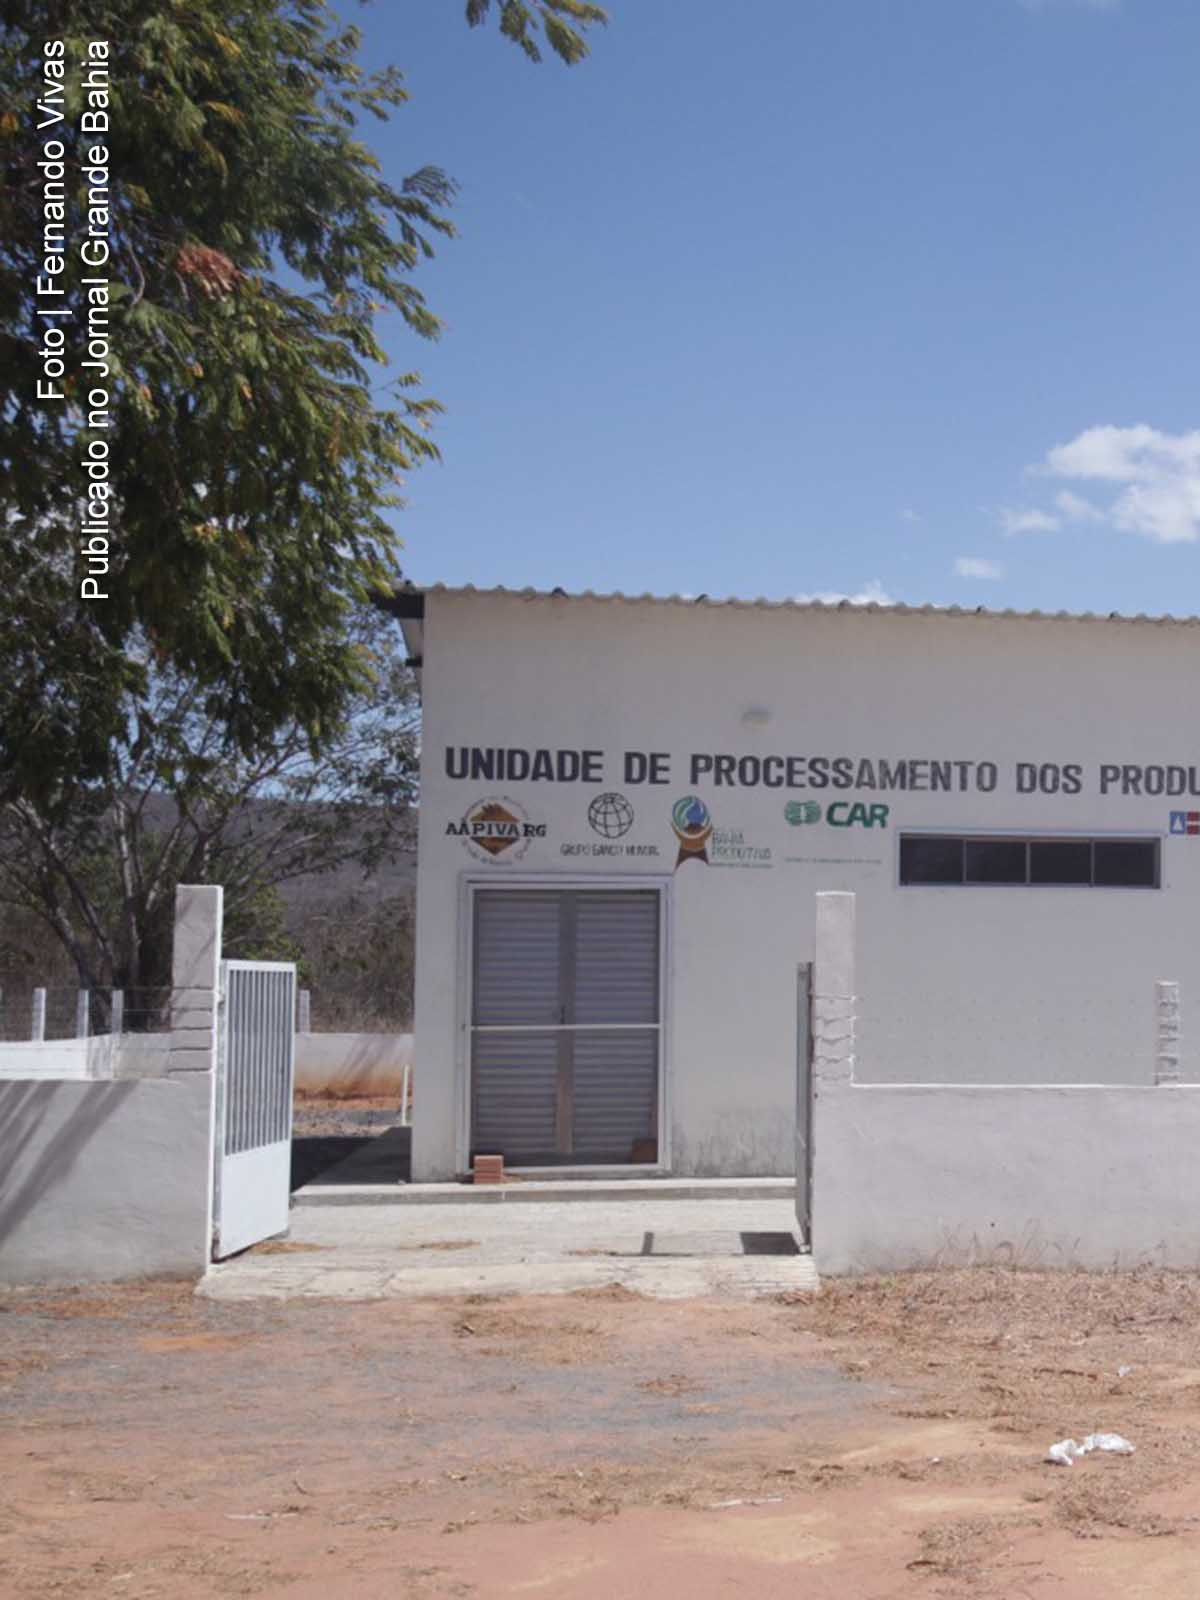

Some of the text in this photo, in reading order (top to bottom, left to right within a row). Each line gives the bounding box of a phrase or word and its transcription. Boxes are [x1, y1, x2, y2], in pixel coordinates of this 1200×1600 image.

[445, 746, 604, 783] UNIDADE
[624, 752, 672, 785] DE
[689, 754, 997, 792] PROCESSAMENTO
[1016, 762, 1082, 794] DOS
[826, 802, 889, 828] CAR
